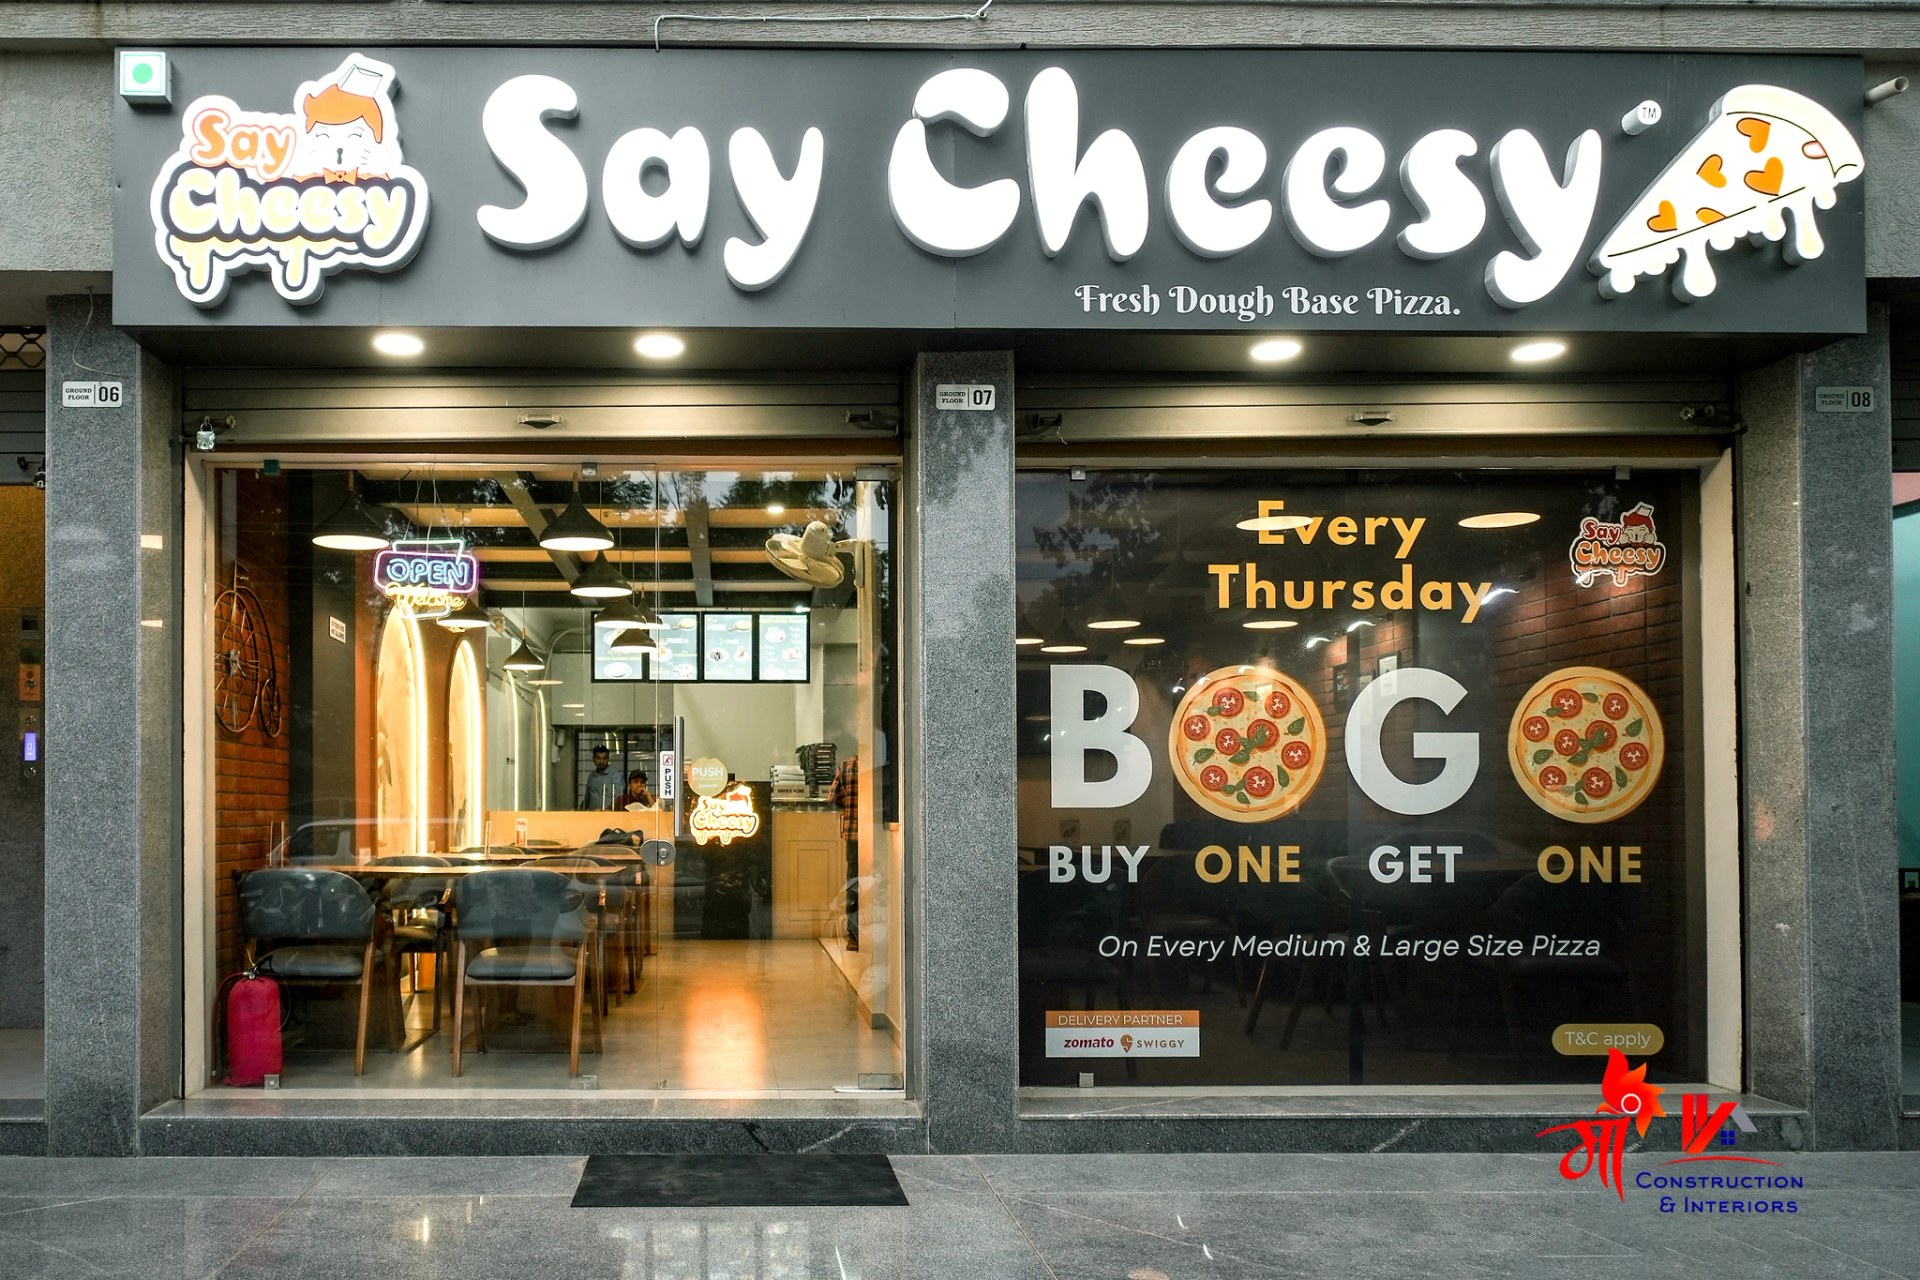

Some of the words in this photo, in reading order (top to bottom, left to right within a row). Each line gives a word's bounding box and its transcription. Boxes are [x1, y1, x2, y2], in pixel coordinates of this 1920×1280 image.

[1642, 107, 1656, 119] TM
[191, 107, 297, 182] Say
[476, 74, 824, 292] Say
[888, 66, 1602, 308] Cheesy
[169, 167, 406, 251] Cheesy
[1074, 284, 1160, 316] Fresh
[1168, 284, 1274, 322] Dough
[1281, 286, 1360, 315] Base
[1366, 287, 1461, 315] Pizza.
[99, 386, 119, 402] 06
[973, 390, 992, 405] 07
[1852, 392, 1870, 407] 08
[1258, 500, 1427, 559] Every
[1583, 520, 1621, 545] Say
[1575, 541, 1661, 571] Cheesy
[386, 557, 469, 586] OPEN
[1208, 563, 1493, 624] Thursday
[692, 767, 724, 777] PUSH
[1048, 845, 1151, 884] BUY
[1194, 845, 1301, 884] ONE
[1368, 845, 1464, 884] GET
[1537, 845, 1642, 884] ONE
[1099, 936, 1138, 957] On
[1147, 936, 1225, 962] Every
[1232, 935, 1345, 957] Medium
[1353, 935, 1371, 956] &
[1380, 935, 1460, 962] Large
[1467, 935, 1523, 956] Size
[1531, 935, 1600, 957] Pizza
[1058, 1015, 1120, 1026] DELIVERY
[1123, 1015, 1183, 1025] PARTNER
[1063, 1037, 1115, 1049] zomato
[1136, 1040, 1185, 1049] SWIGGY
[1564, 1032, 1598, 1046] T&C
[1603, 1032, 1651, 1049] apply
